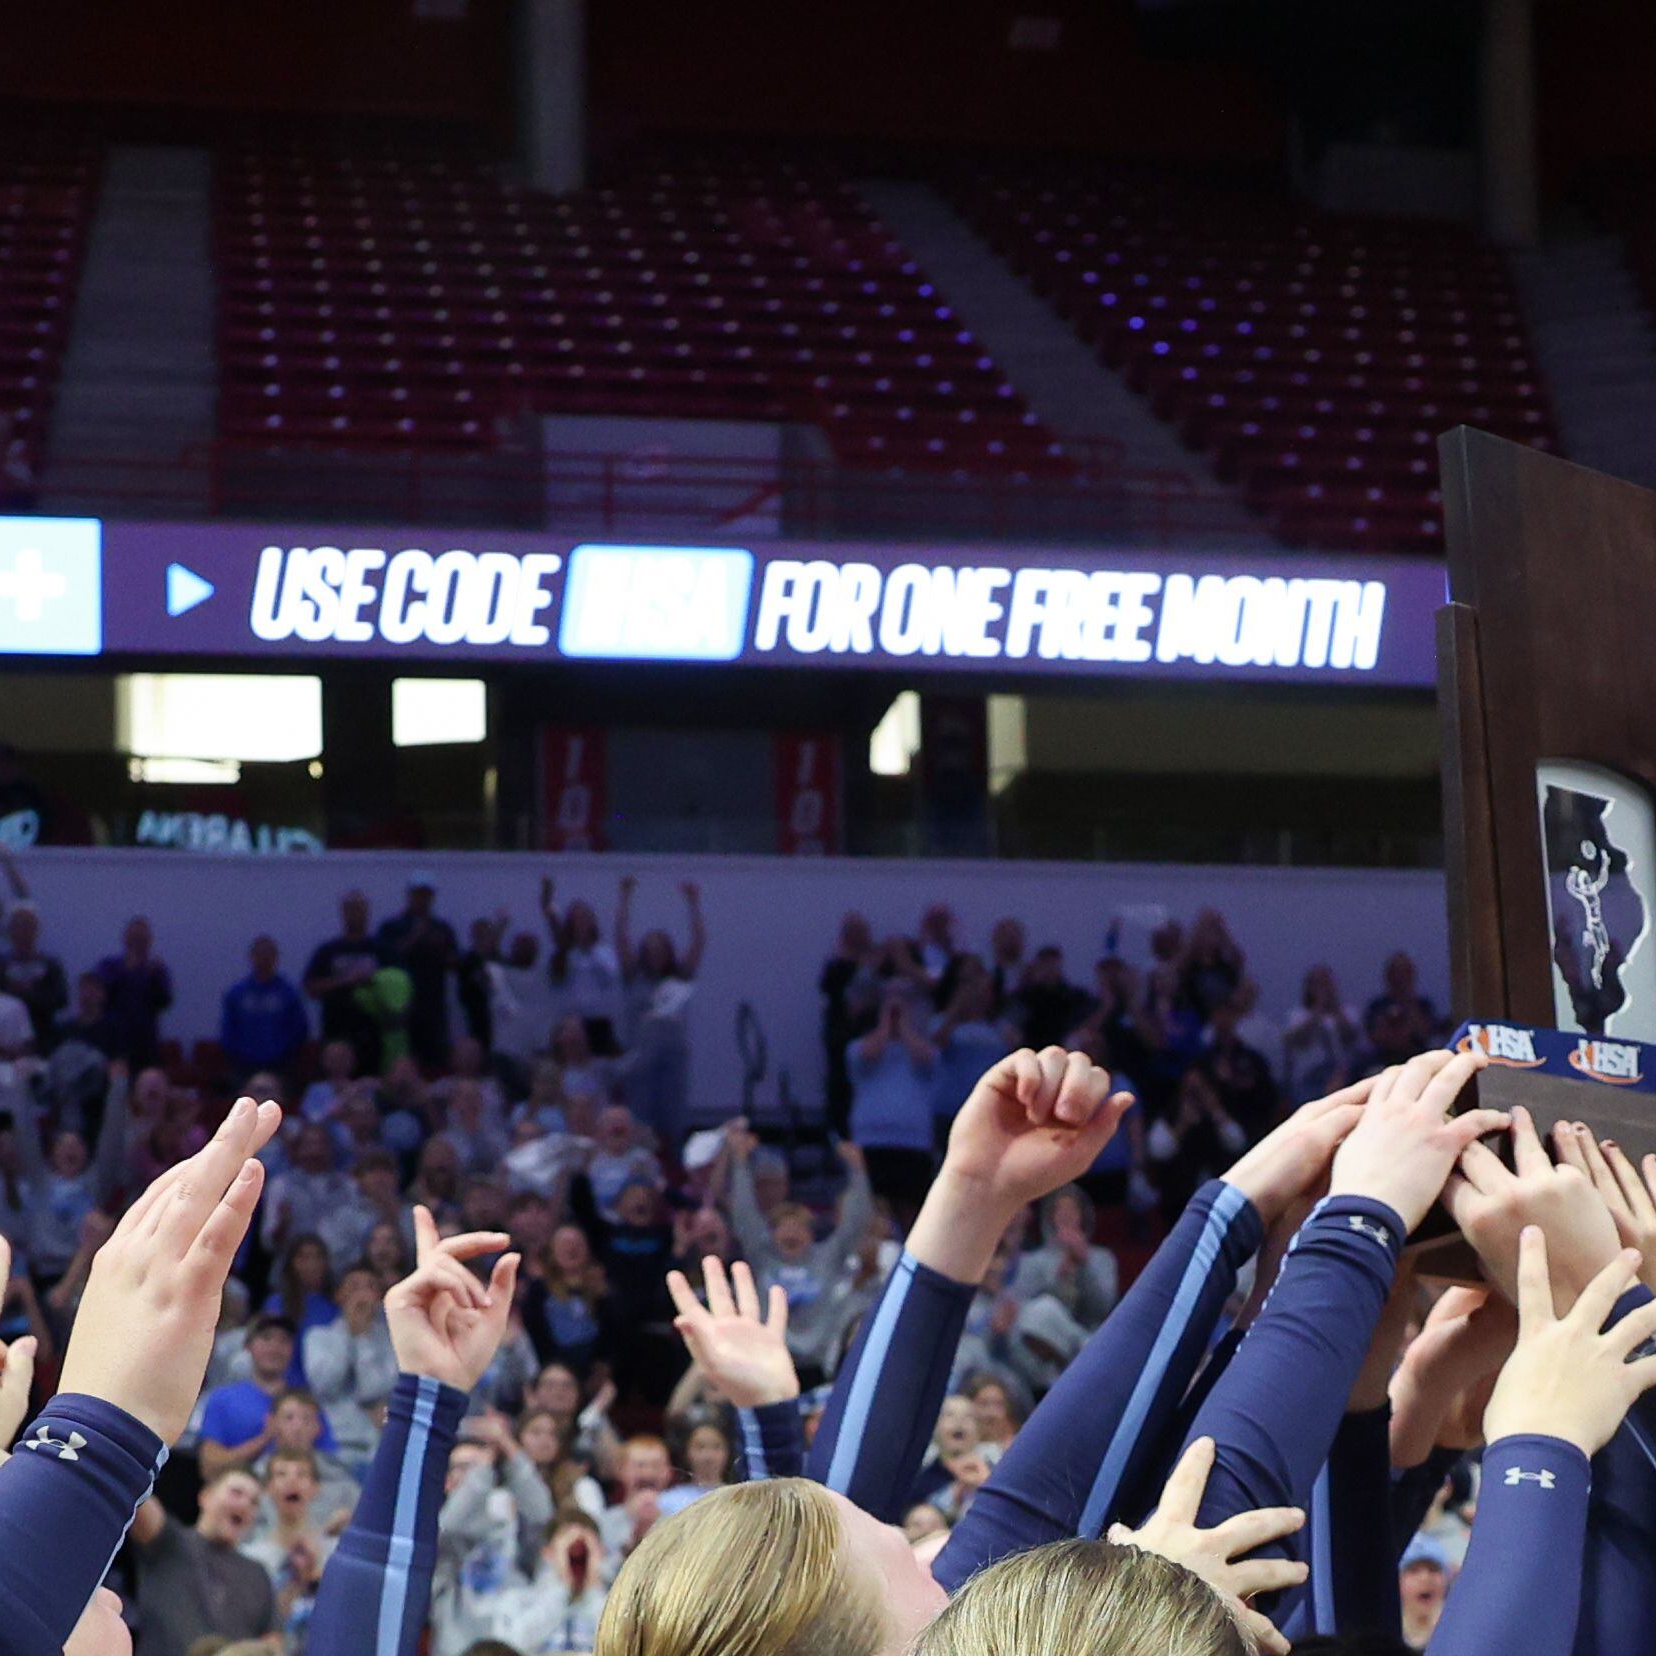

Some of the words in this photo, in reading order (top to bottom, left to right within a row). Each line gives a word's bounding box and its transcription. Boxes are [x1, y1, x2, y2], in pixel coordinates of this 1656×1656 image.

[250, 546, 386, 642] USE
[380, 549, 562, 646] CODE
[755, 560, 881, 653] FOR
[879, 564, 1012, 658] ONE
[1005, 569, 1161, 662] FREE
[1157, 573, 1386, 670] MONTH
[1577, 1038, 1641, 1078] IHSA
